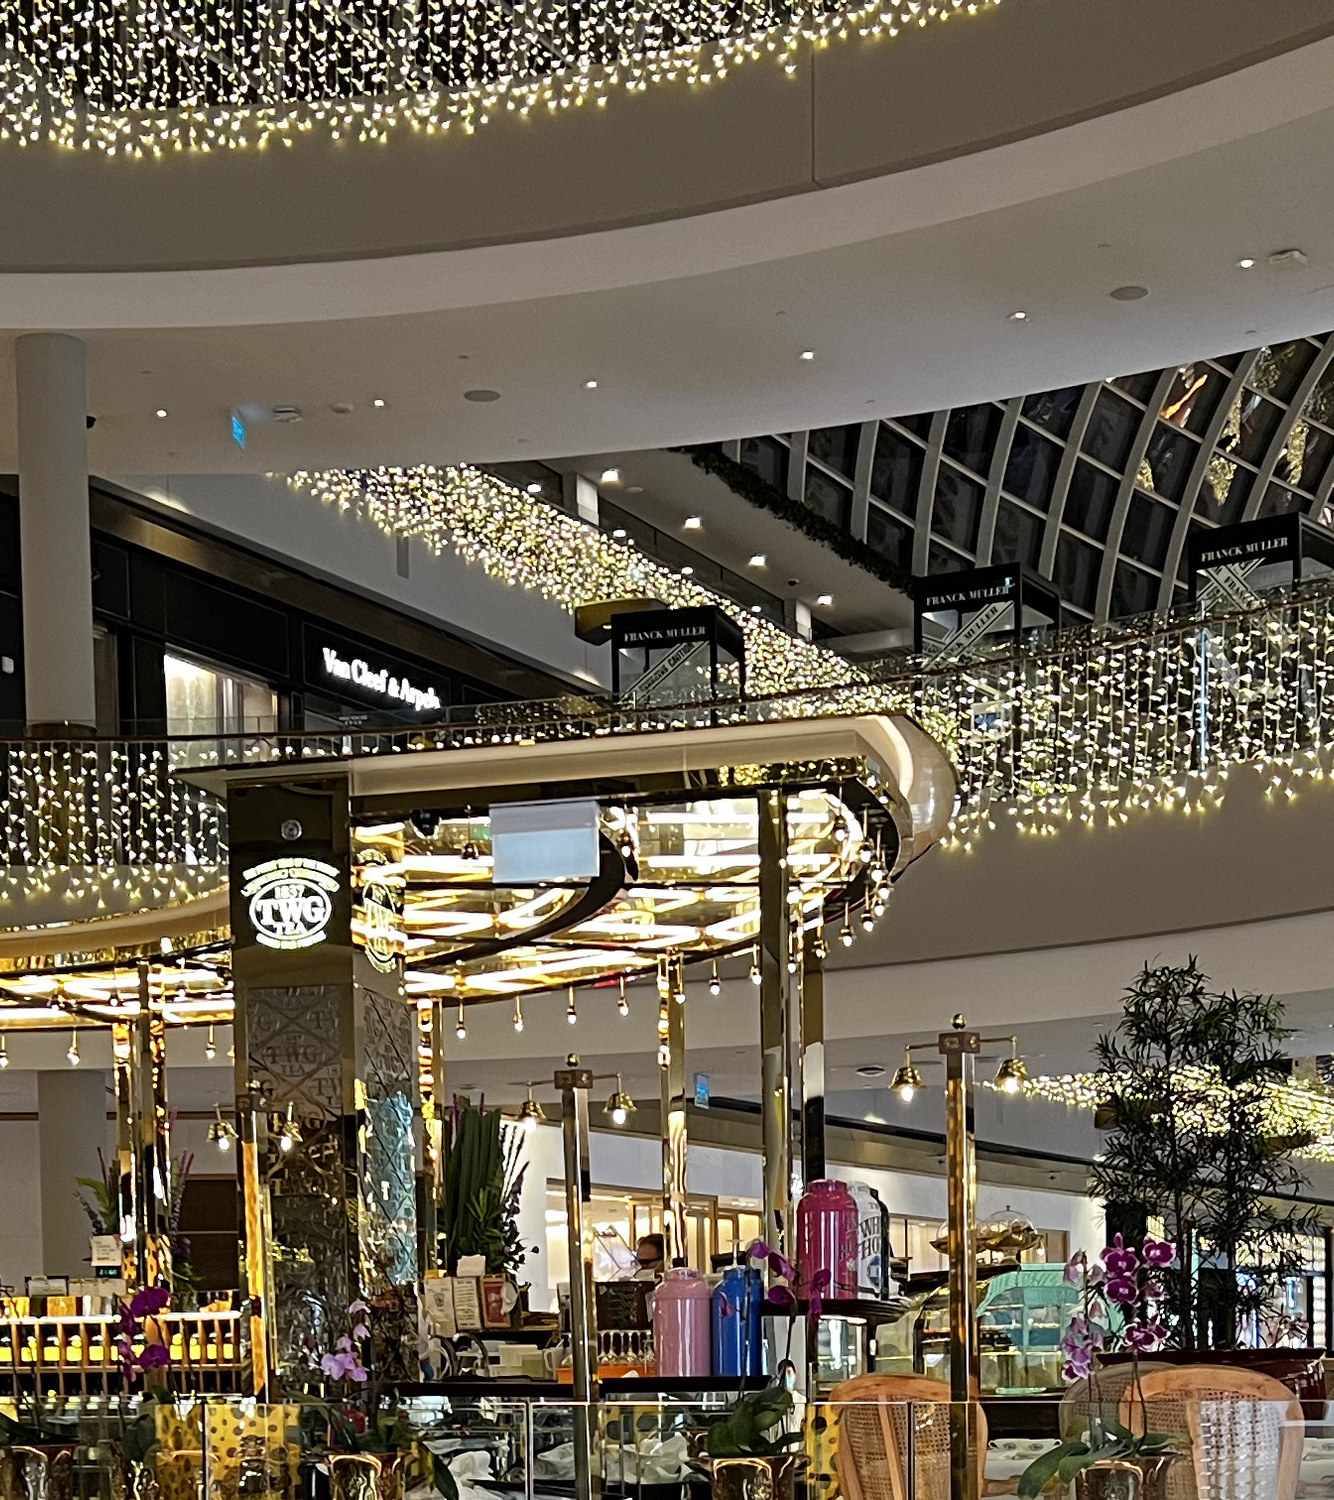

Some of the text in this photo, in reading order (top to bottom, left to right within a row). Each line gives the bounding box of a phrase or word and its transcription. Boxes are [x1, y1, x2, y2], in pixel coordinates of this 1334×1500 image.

[1201, 537, 1288, 562] FRANCK MULLER
[926, 585, 1010, 606] FRANCK MULLER
[624, 626, 706, 642] FRANCK MULLER
[274, 885, 305, 899] 1837
[255, 895, 325, 926] TWG
[275, 923, 308, 936] TEA
